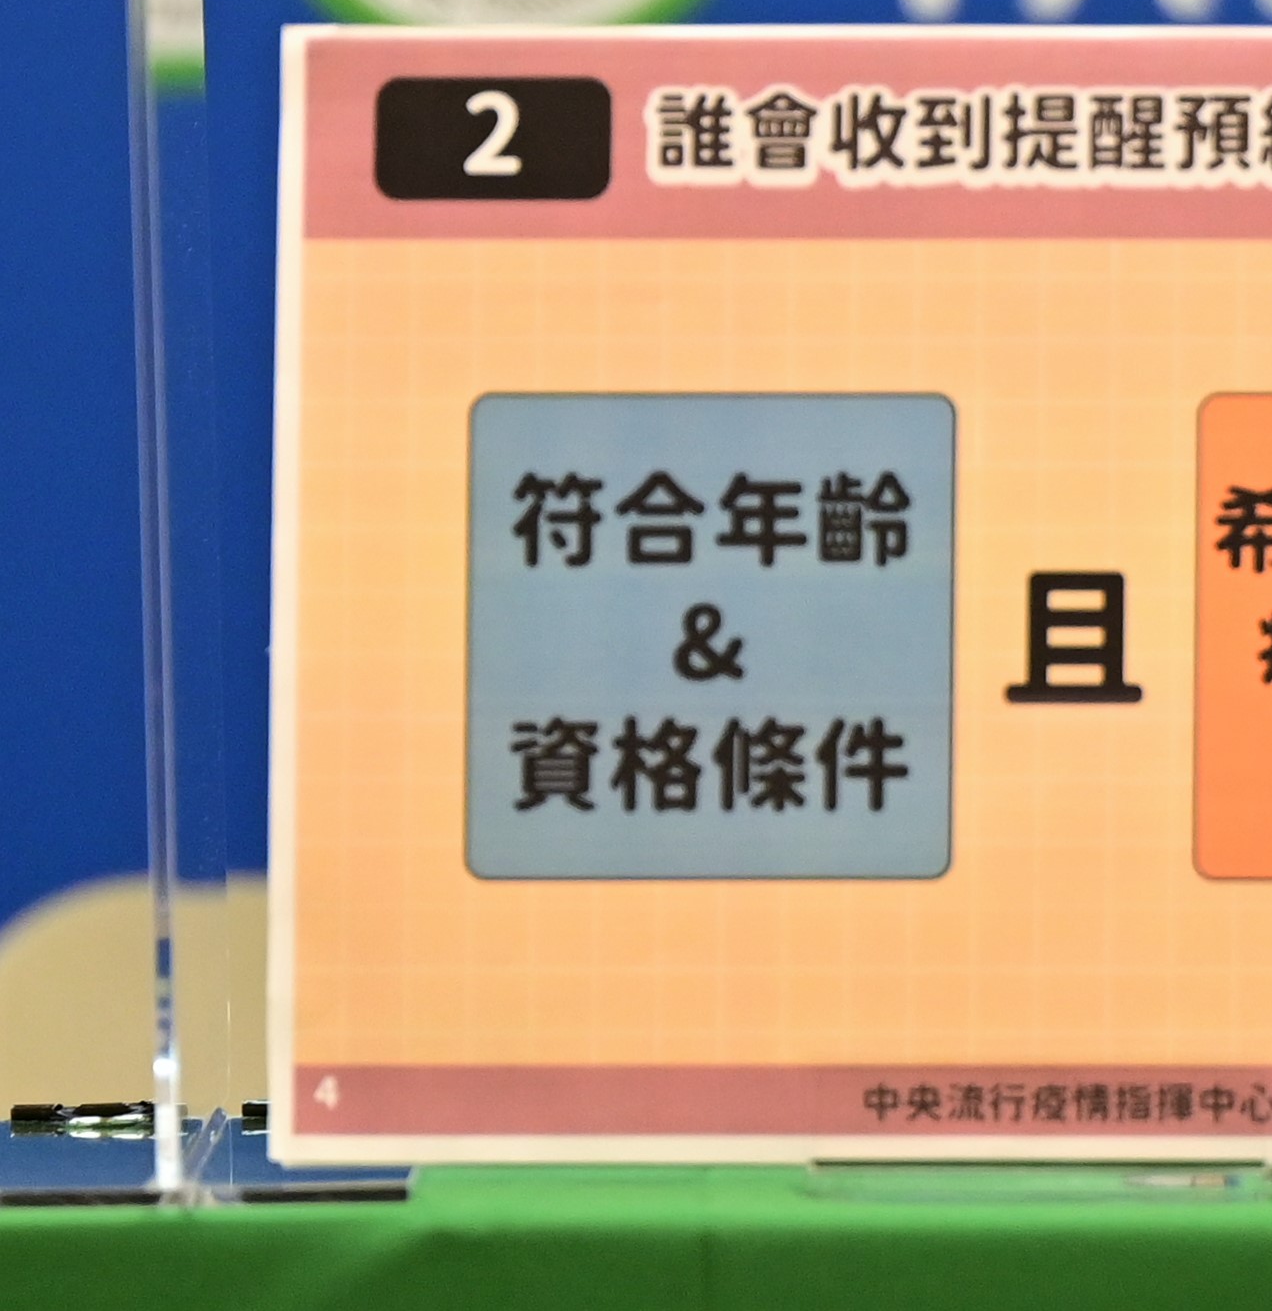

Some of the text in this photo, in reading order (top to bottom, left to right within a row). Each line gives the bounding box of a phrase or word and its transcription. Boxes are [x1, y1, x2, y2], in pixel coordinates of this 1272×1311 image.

[462, 89, 522, 176] 2
[511, 469, 912, 569] 符合年齡
[672, 601, 746, 683] &
[1003, 570, 1144, 705] 且
[509, 714, 910, 814] 資格條件
[312, 1074, 341, 1111] 4
